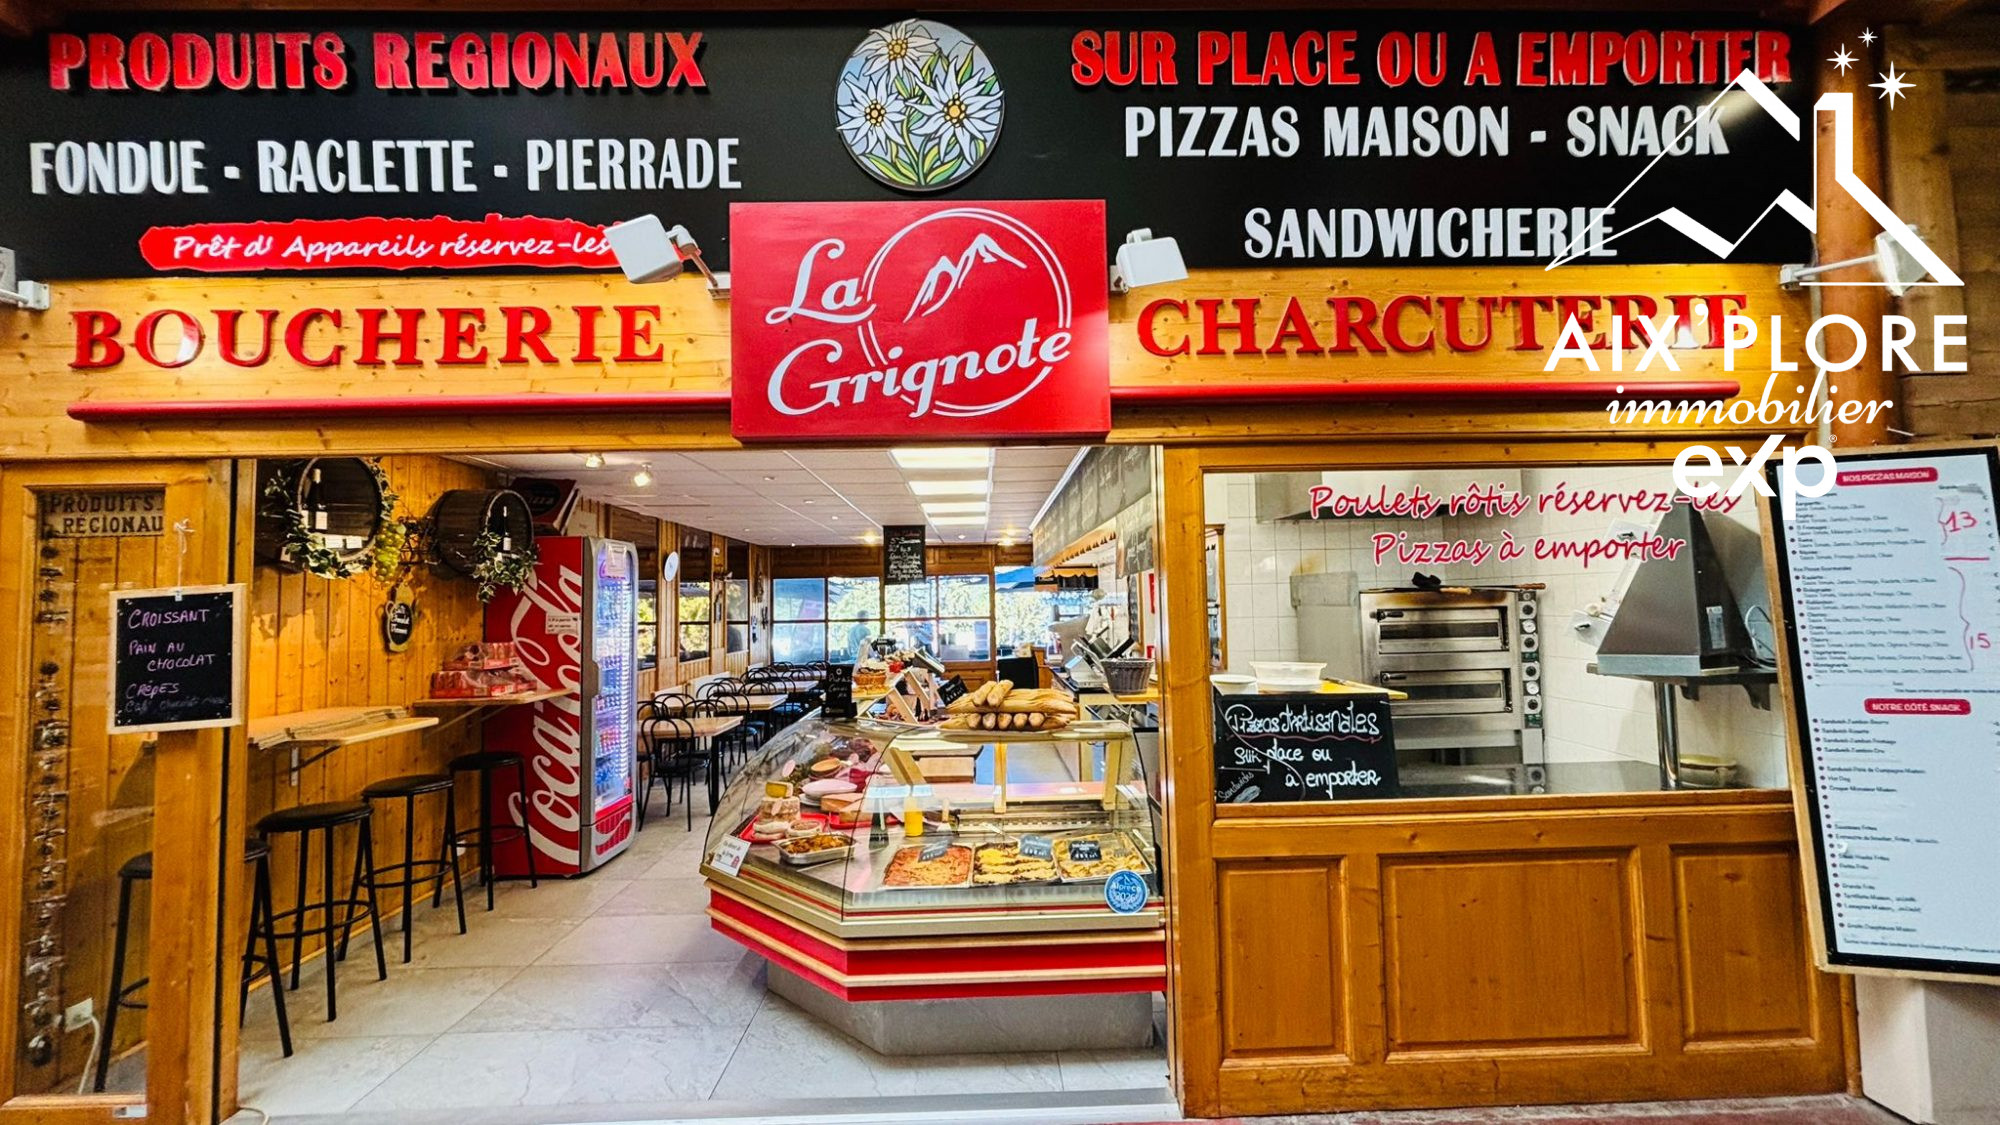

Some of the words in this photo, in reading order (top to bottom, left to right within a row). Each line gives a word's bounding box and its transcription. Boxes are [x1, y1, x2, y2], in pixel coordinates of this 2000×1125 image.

[50, 31, 348, 91] PRODUITS
[374, 31, 707, 90] REGIONAUX
[1071, 29, 1177, 87] SUR
[1197, 29, 1360, 87] PLACE
[1377, 29, 1450, 87] OU
[1464, 29, 1502, 87] A
[1516, 29, 1793, 87] EMPORTER
[1125, 105, 1301, 159] PIZZAS
[1323, 105, 1509, 158] MAISON
[1566, 105, 1731, 158] SNACK
[30, 141, 208, 195] FONDUE
[257, 139, 477, 193] RACLETTE
[527, 138, 742, 191] PIERRADE
[173, 233, 242, 260] Prêt
[283, 233, 429, 262] Appareils
[438, 229, 613, 259] réservez-les
[1243, 207, 1619, 260] SANDWICHERIE
[765, 238, 877, 324] La
[67, 306, 664, 370] BOUCHERIE
[1139, 294, 1747, 358] CHARCUTERIE
[767, 317, 1072, 418] Grignote
[48, 495, 155, 513] PRODUITS
[1308, 485, 1441, 518] Poulets
[1448, 482, 1528, 517] rôtis
[1371, 532, 1493, 567] Pizzas
[1498, 528, 1527, 563] à
[1533, 531, 1687, 570] emporter
[128, 608, 210, 629] CROISSANT
[129, 640, 157, 656] PAIN
[167, 642, 185, 653] AU
[147, 653, 216, 671] CHOCOLAT
[1312, 747, 1333, 762] ou
